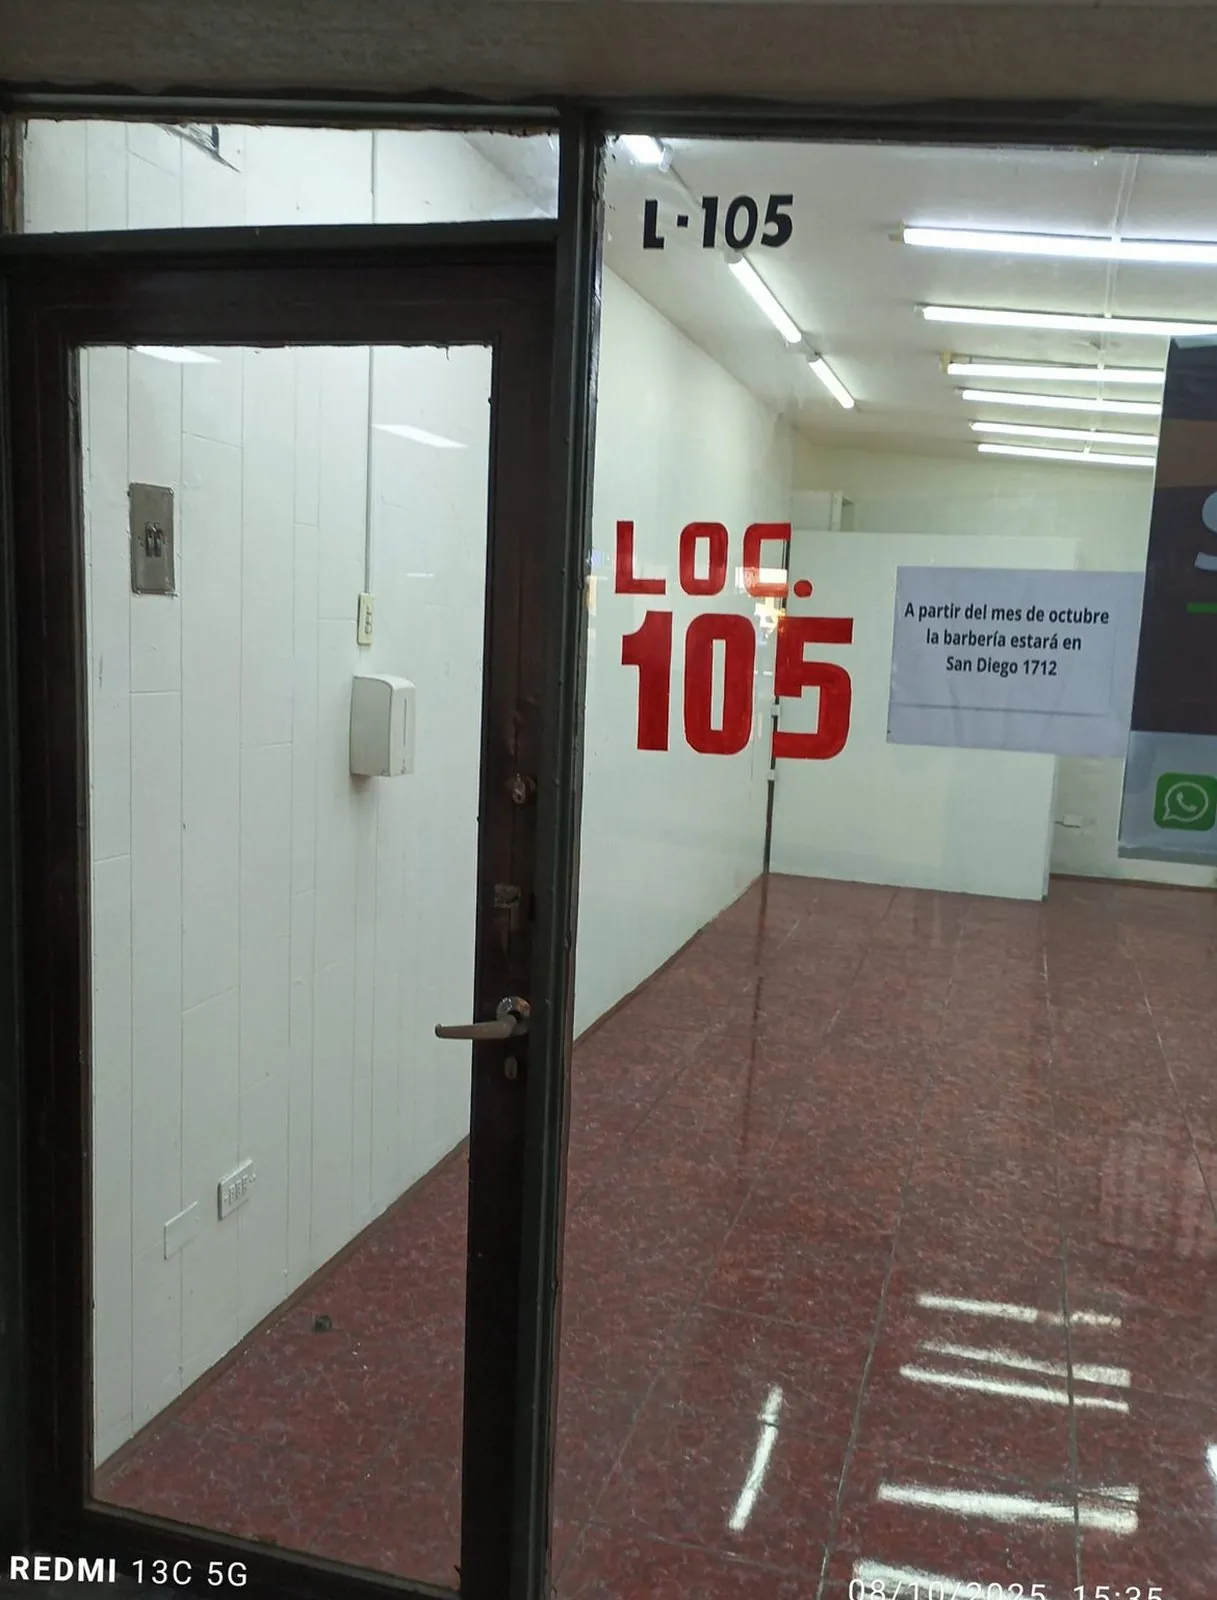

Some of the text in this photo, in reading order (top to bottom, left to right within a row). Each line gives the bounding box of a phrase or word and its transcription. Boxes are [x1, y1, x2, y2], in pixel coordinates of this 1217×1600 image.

[643, 193, 794, 250] L-105
[615, 520, 813, 599] LOC.
[904, 602, 1109, 624] A partir del mes de octubre
[926, 628, 1082, 650] la barbería estará en
[621, 610, 853, 760] 105
[946, 656, 1057, 678] San Diego 1712
